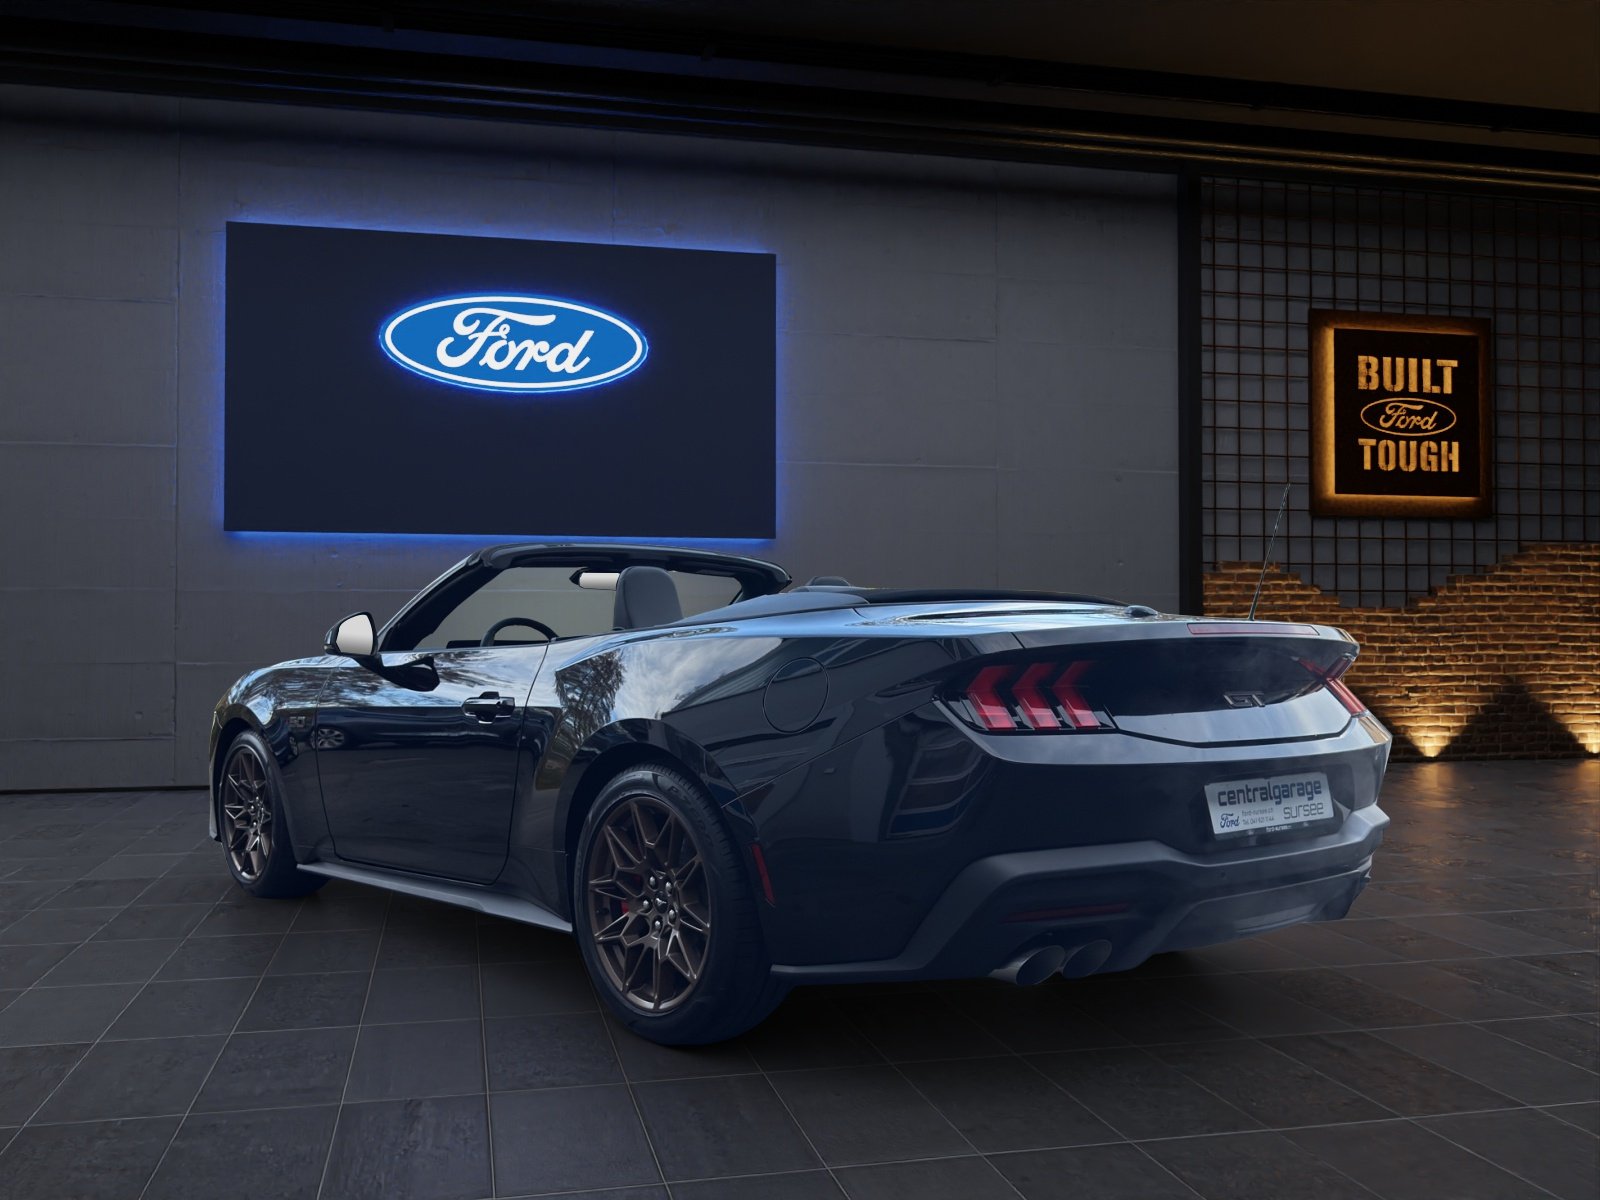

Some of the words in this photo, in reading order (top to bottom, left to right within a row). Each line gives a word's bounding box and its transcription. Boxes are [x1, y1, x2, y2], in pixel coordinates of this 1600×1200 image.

[436, 307, 595, 374] Ford
[1357, 354, 1459, 395] BUILT
[1379, 402, 1439, 431] Ford
[1357, 437, 1461, 473] TOUGH
[1217, 780, 1322, 806] centralgarage
[1220, 812, 1240, 829] Ford
[1283, 802, 1324, 820] sursee
